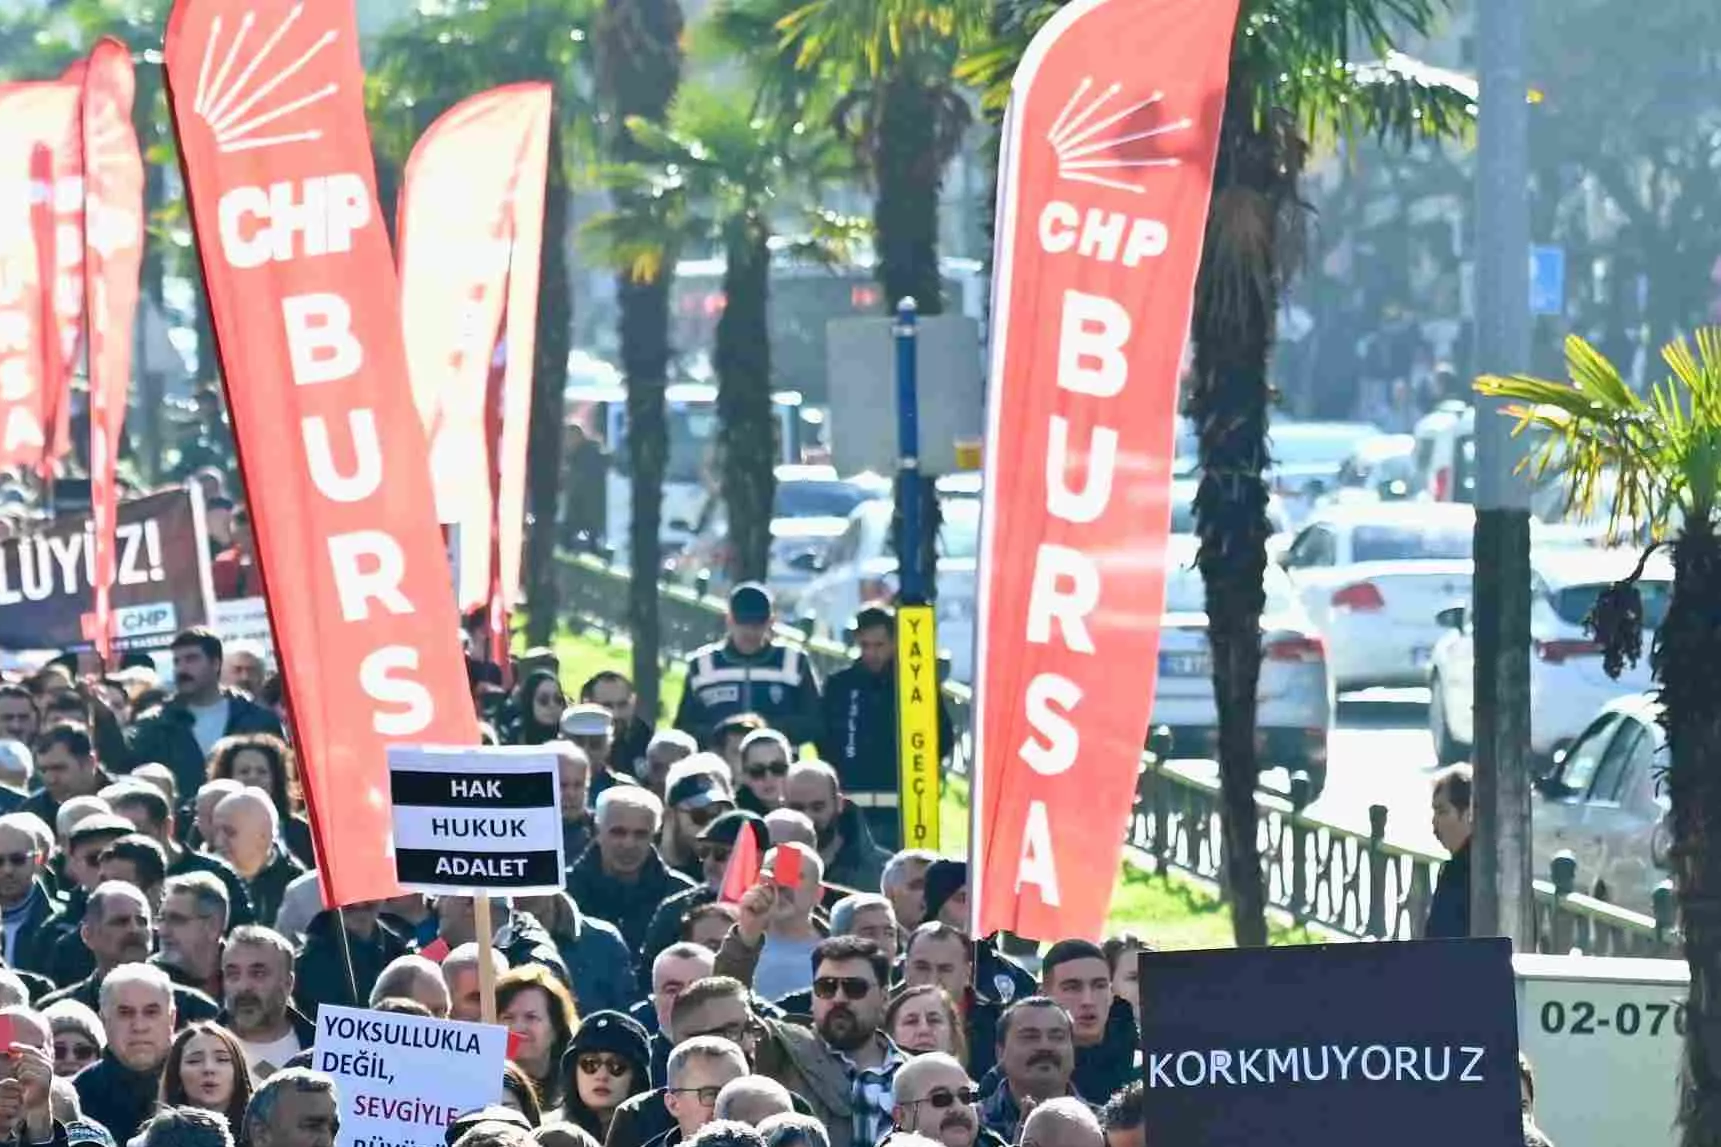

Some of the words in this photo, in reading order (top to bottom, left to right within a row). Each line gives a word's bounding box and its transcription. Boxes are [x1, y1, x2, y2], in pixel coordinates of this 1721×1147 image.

[218, 172, 372, 269] CHP
[1037, 200, 1169, 269] CHP
[281, 292, 435, 740] BURS
[1015, 289, 1132, 908] BURSA
[450, 779, 503, 799] HAK
[431, 817, 528, 838] HUKUK
[434, 856, 529, 878] ADALET
[324, 1015, 481, 1055] YOKSULLUKLA
[321, 1049, 396, 1085] DEĞİL,
[1148, 1045, 1486, 1089] KORKMUYORUZ
[352, 1095, 460, 1128] SEVGİYLE
